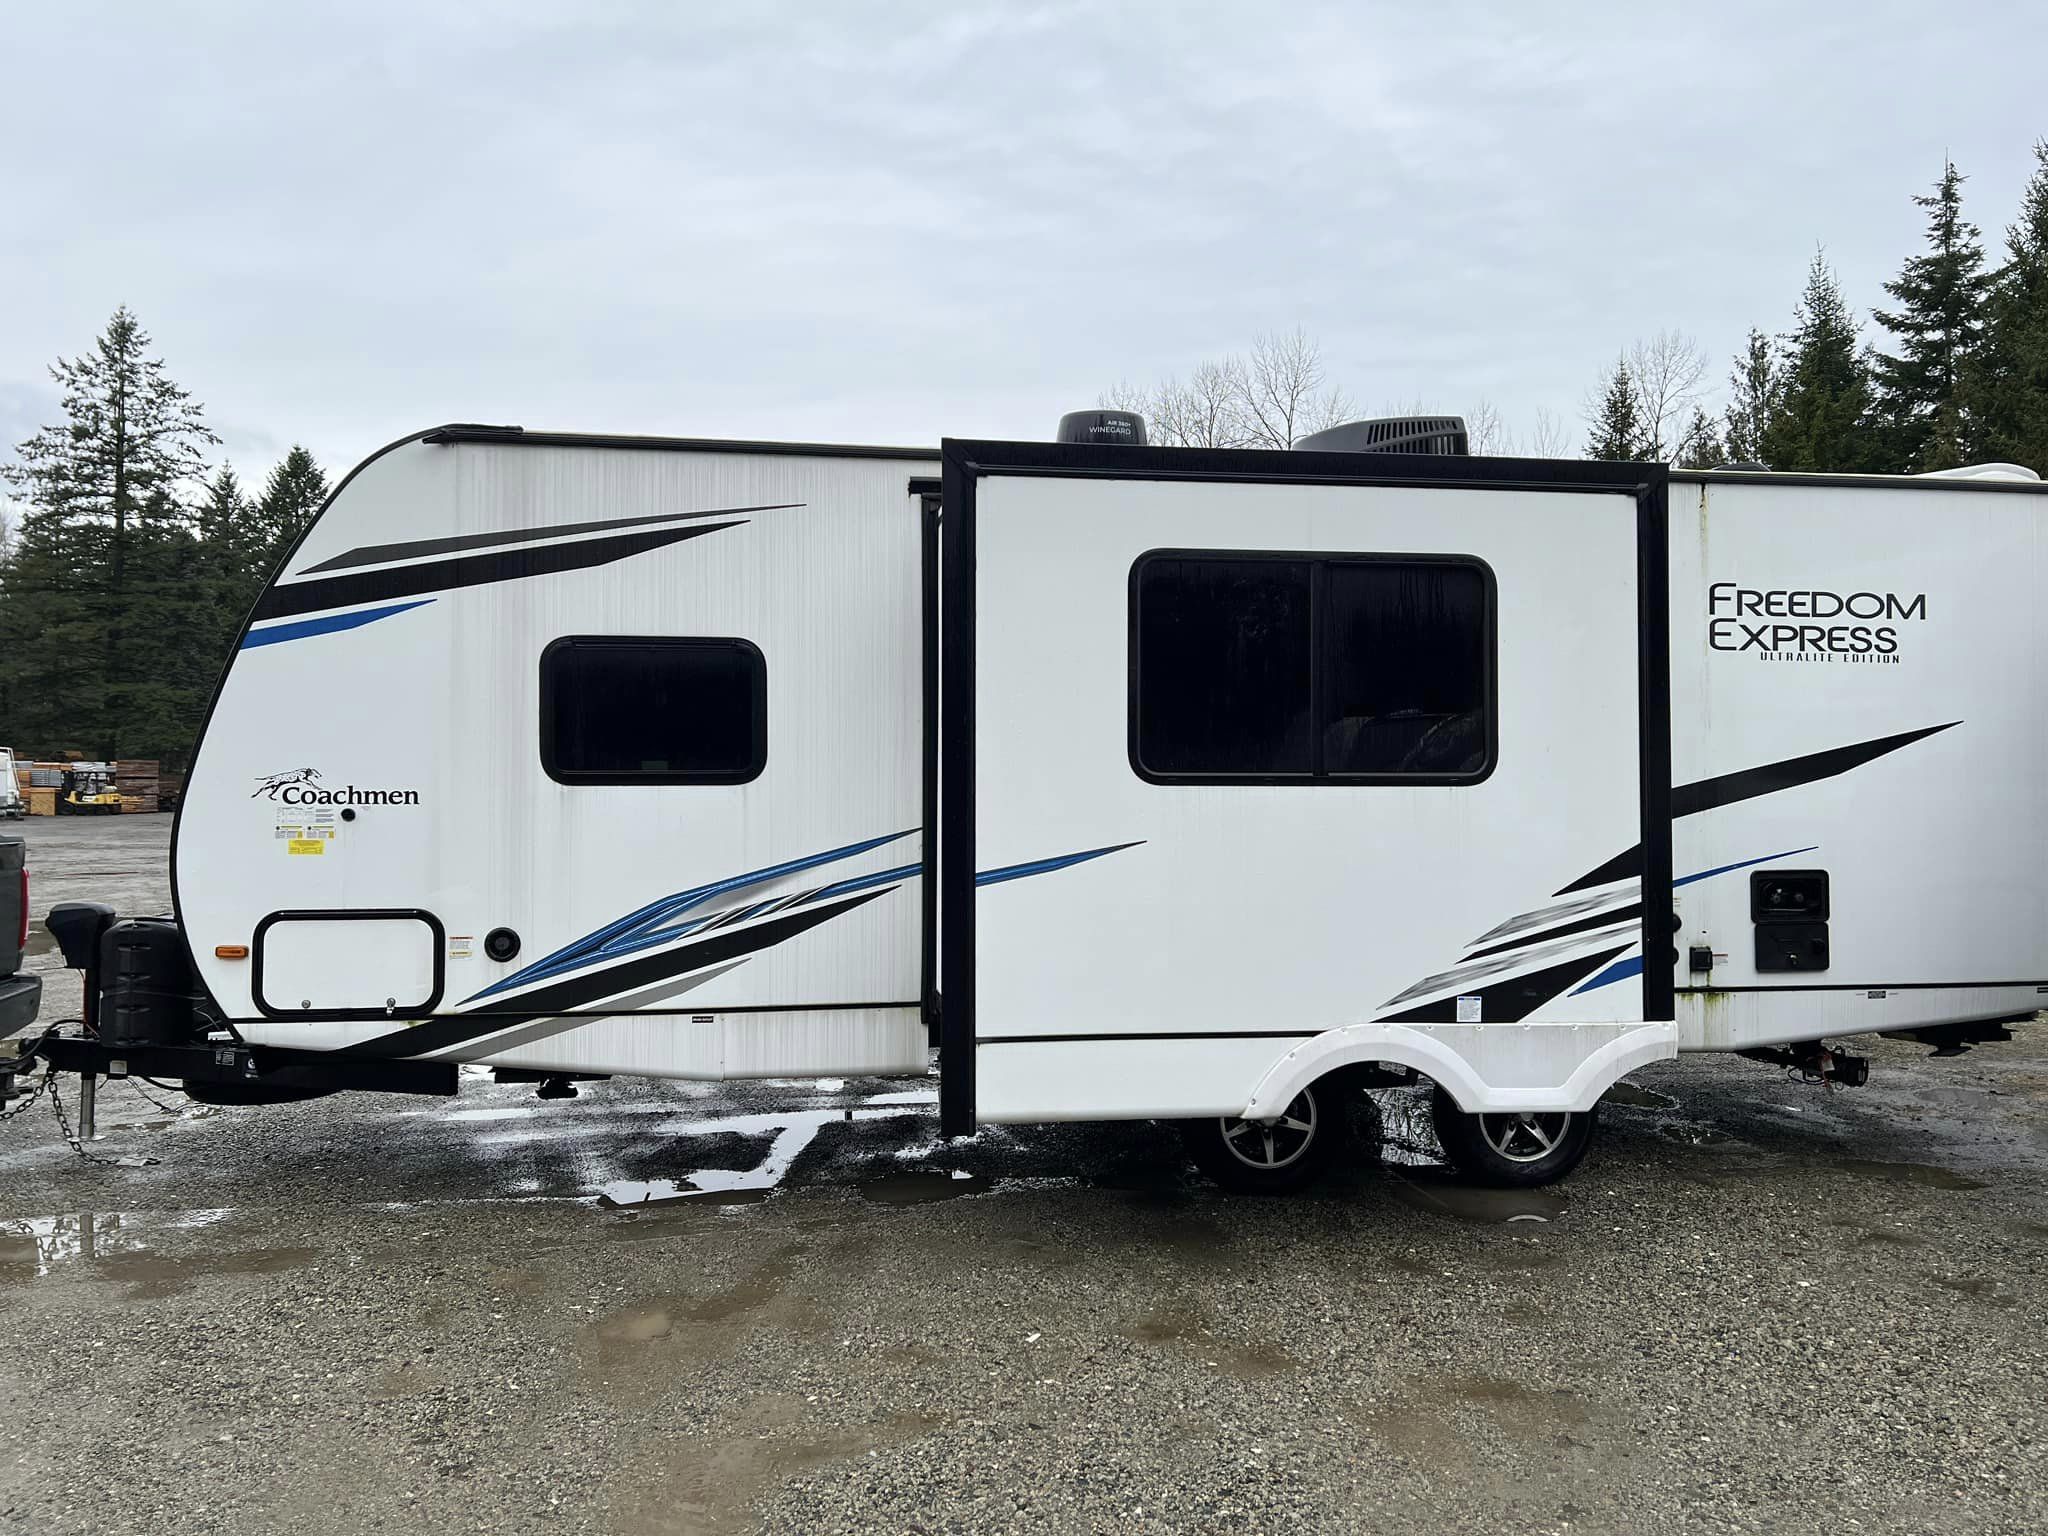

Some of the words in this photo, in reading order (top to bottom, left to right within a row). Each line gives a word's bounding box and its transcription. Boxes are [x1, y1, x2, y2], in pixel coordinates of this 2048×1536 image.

[1089, 426, 1132, 435] WINEGARD
[1708, 582, 1926, 621] FREEDOM
[1708, 618, 1899, 654] EXPRESS
[1760, 652, 1834, 662] ULTRALITE
[1843, 653, 1900, 664] EDITION
[282, 785, 420, 805] Coachmen
